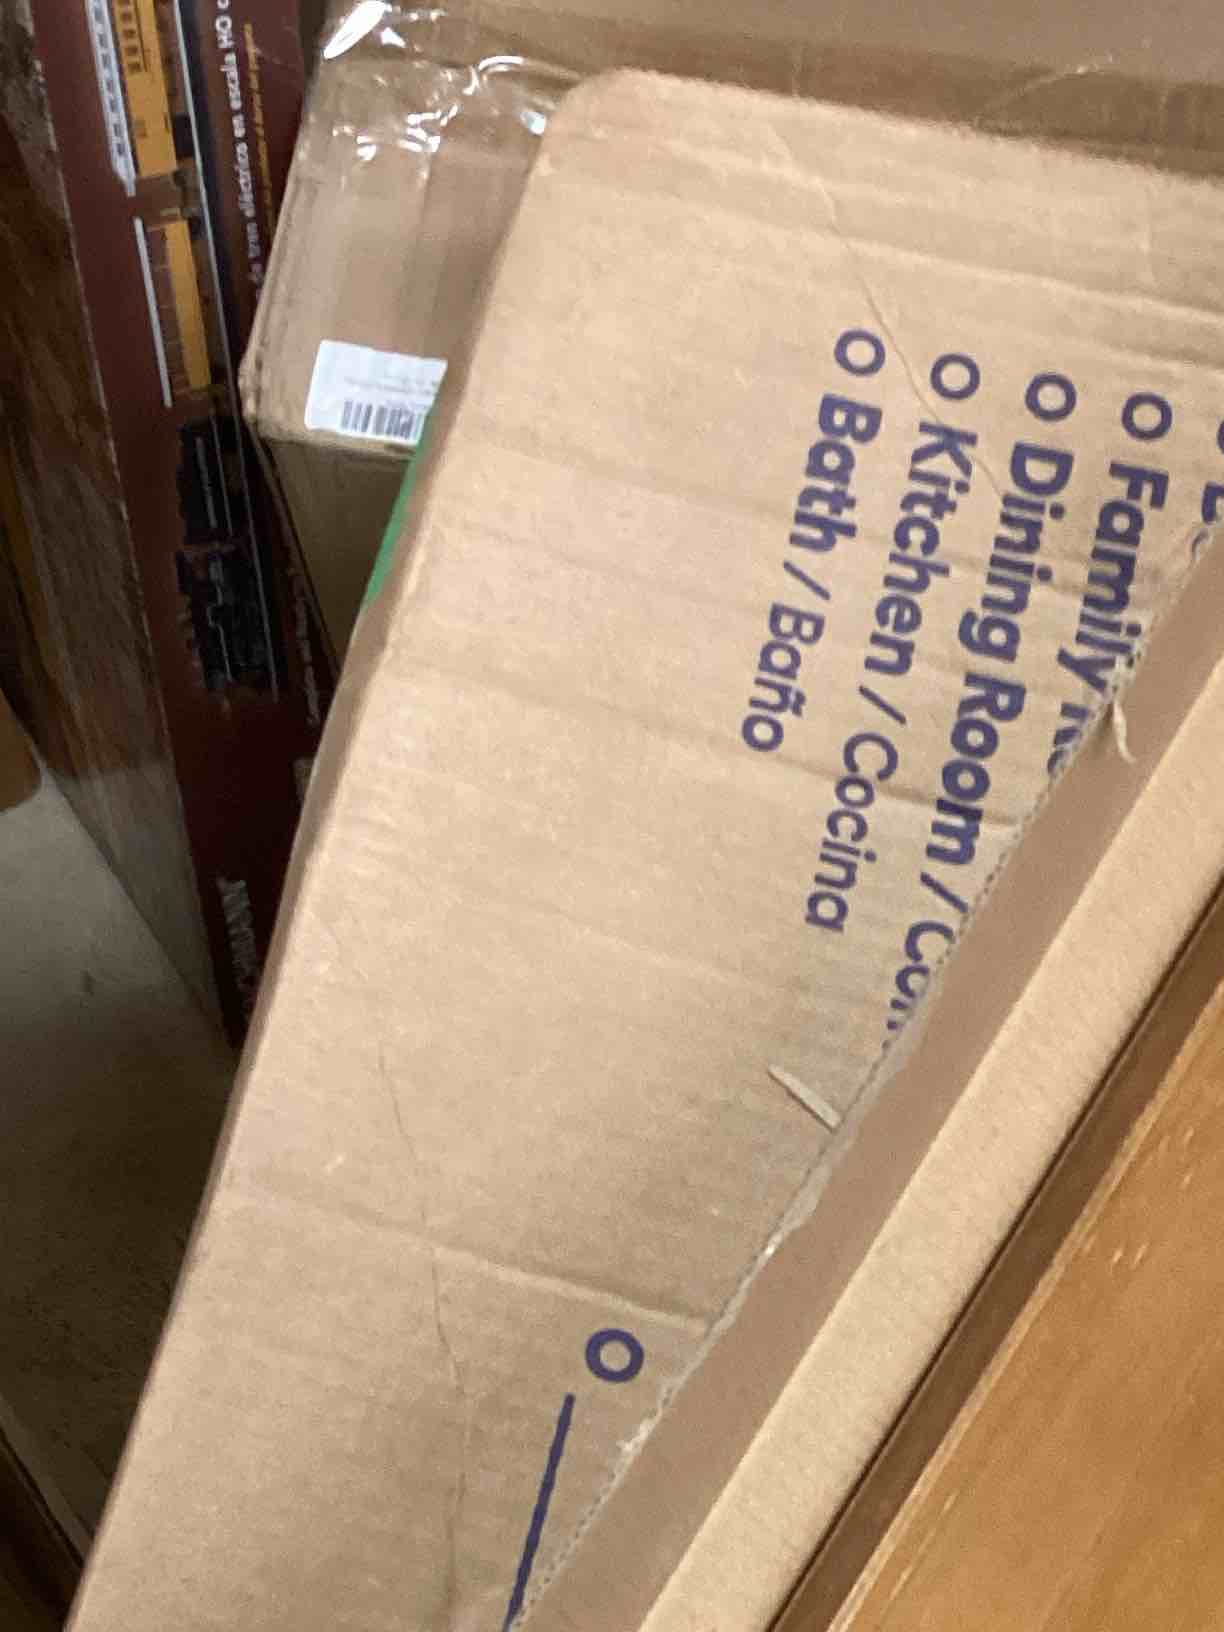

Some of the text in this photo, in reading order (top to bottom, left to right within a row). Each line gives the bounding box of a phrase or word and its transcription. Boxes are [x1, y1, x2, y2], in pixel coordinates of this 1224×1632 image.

[789, 394, 884, 553] Bath
[863, 421, 978, 677] Kitchen
[958, 441, 1075, 664] Dining
[741, 603, 826, 753] Baño
[1057, 463, 1168, 694] Family
[805, 732, 899, 934] Cocina
[925, 671, 1026, 866] Room
